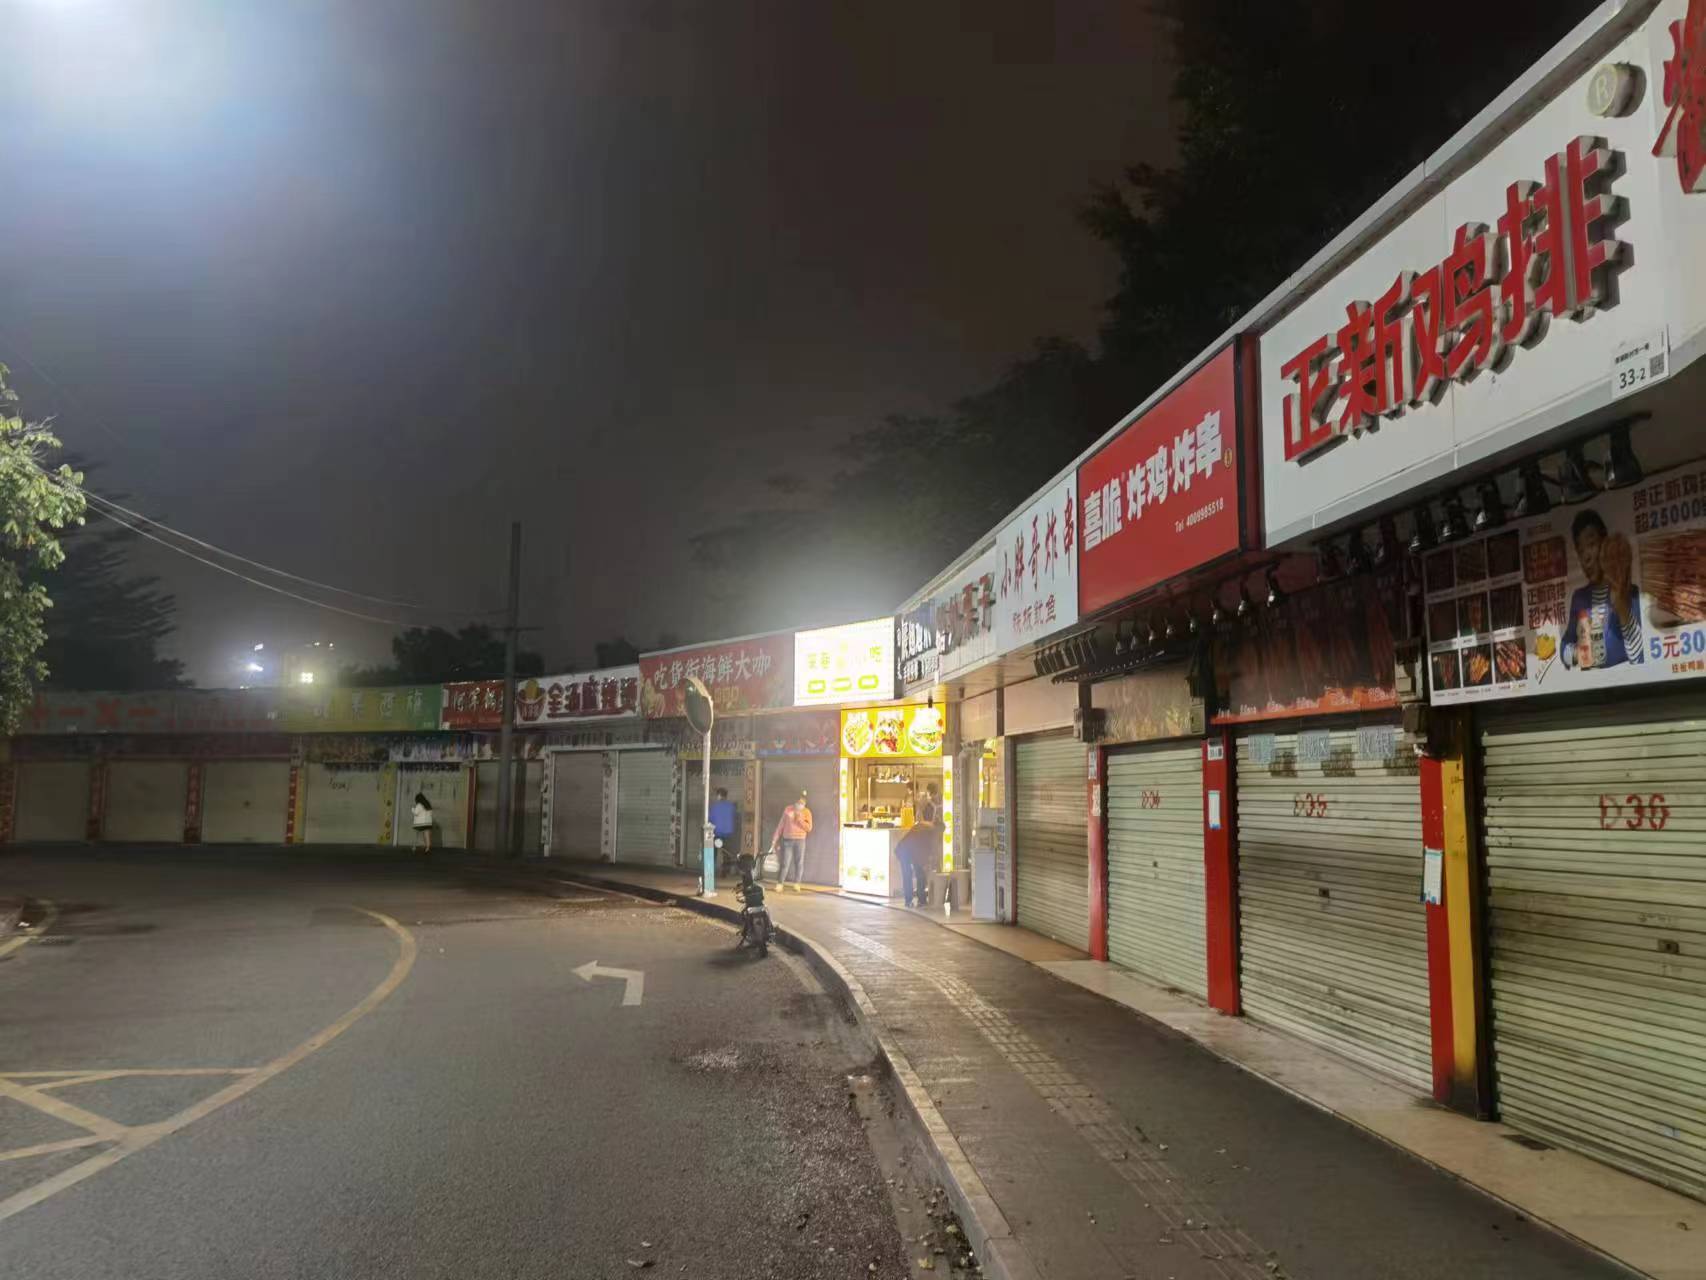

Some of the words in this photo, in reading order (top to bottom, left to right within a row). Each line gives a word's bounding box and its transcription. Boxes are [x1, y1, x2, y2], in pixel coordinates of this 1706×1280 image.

[1281, 136, 1630, 460] 正新鸡排
[1619, 367, 1646, 389] 33-2
[653, 649, 772, 690] 吃货街海鲜大咖
[1599, 792, 1671, 831] D36
